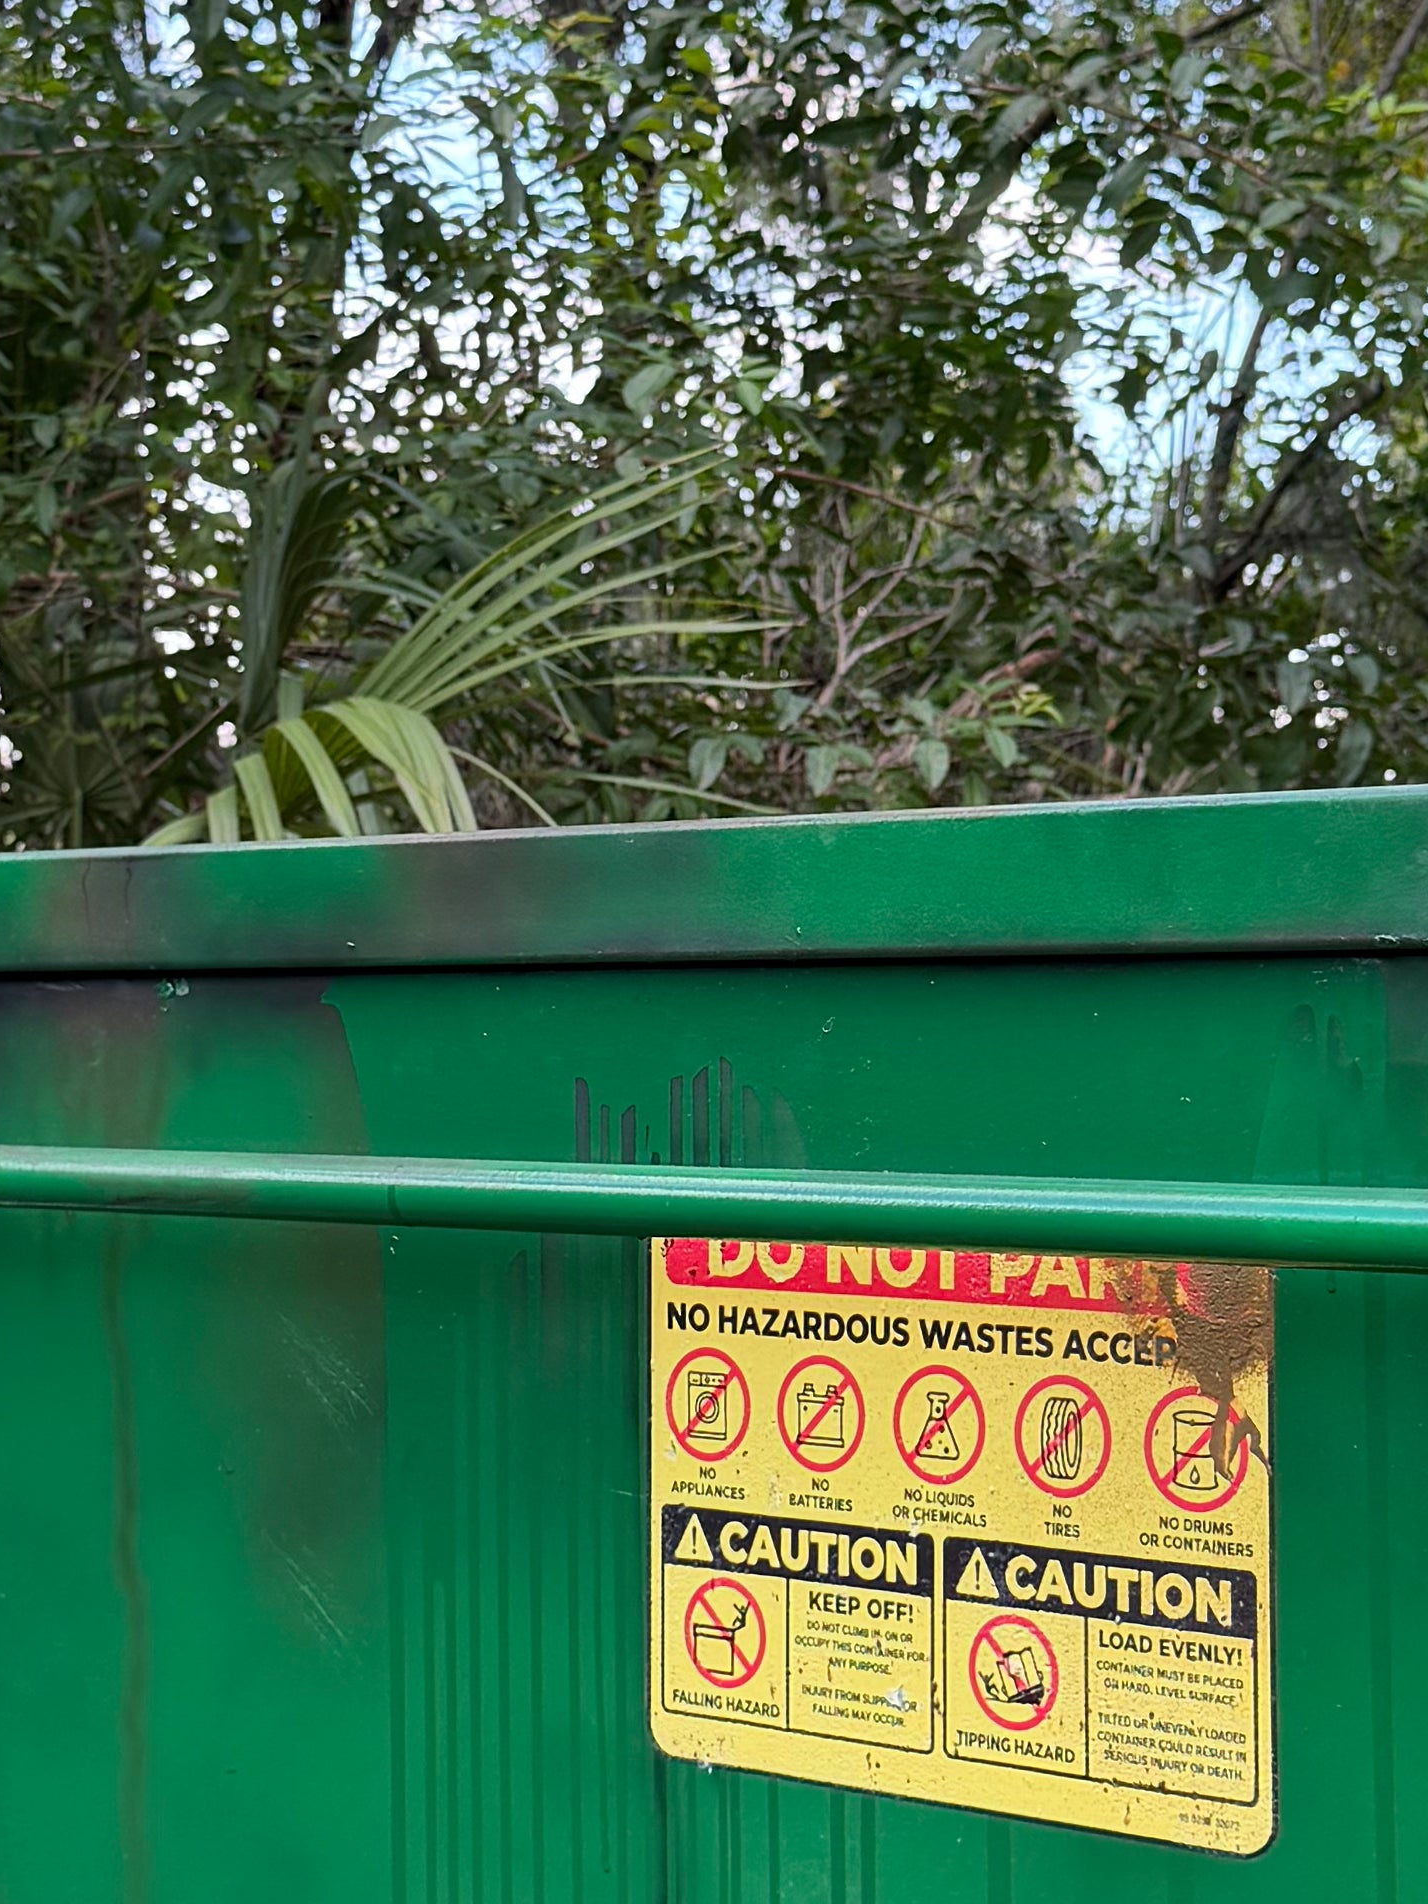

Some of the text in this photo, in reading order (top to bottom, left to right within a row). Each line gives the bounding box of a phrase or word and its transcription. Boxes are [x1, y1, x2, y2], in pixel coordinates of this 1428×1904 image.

[708, 1239, 1189, 1304] DO NOT PAR
[667, 1301, 1177, 1368] NO HAZARDOUS WASTES ACCEP
[698, 1466, 717, 1480] NO
[811, 1477, 830, 1492] NO
[671, 1480, 746, 1500] APPLIANCES
[788, 1492, 854, 1512] BATTERIES
[903, 1488, 976, 1507] NO LIQUIDS
[892, 1505, 988, 1528] OR CHEMICALS
[1052, 1504, 1073, 1518] NO
[1044, 1521, 1081, 1539] TIRES
[1158, 1516, 1234, 1536] NO DRUMS
[719, 1521, 917, 1586] CAUTION
[1139, 1533, 1254, 1558] OR CONTAINERS
[1004, 1554, 1232, 1627] CAUTION
[809, 1590, 913, 1624] KEEP OFF!
[807, 1620, 820, 1631] DO
[822, 1621, 841, 1634] NOT
[842, 1624, 869, 1638] CLIMB
[885, 1630, 898, 1642] ON
[900, 1633, 913, 1643] OR
[794, 1635, 830, 1649] OCCUPY
[832, 1640, 852, 1653] THIS
[854, 1643, 905, 1660] CONTAINER
[1099, 1629, 1243, 1667] LOAD EVENLY!
[829, 1656, 848, 1669] ANY
[1096, 1660, 1244, 1690] CONTAINER MUST BE PLACED
[802, 1684, 918, 1713] INJURY FROM SLIPP OR
[1104, 1677, 1119, 1690] ON
[1155, 1685, 1186, 1700] LEVEL
[672, 1689, 781, 1718] FALLING HAZARD
[812, 1703, 849, 1719] FALLING
[852, 1709, 872, 1722] MAY
[1098, 1711, 1247, 1744] TILTED OR UNEVENLY LOADED
[955, 1730, 1076, 1764] TIPPING HAZARD
[1097, 1730, 1247, 1763] CONTAINER COULD RESULT IN
[1104, 1749, 1148, 1766] SERIOUS
[1150, 1756, 1188, 1771] INJURY
[1190, 1762, 1205, 1775] OR
